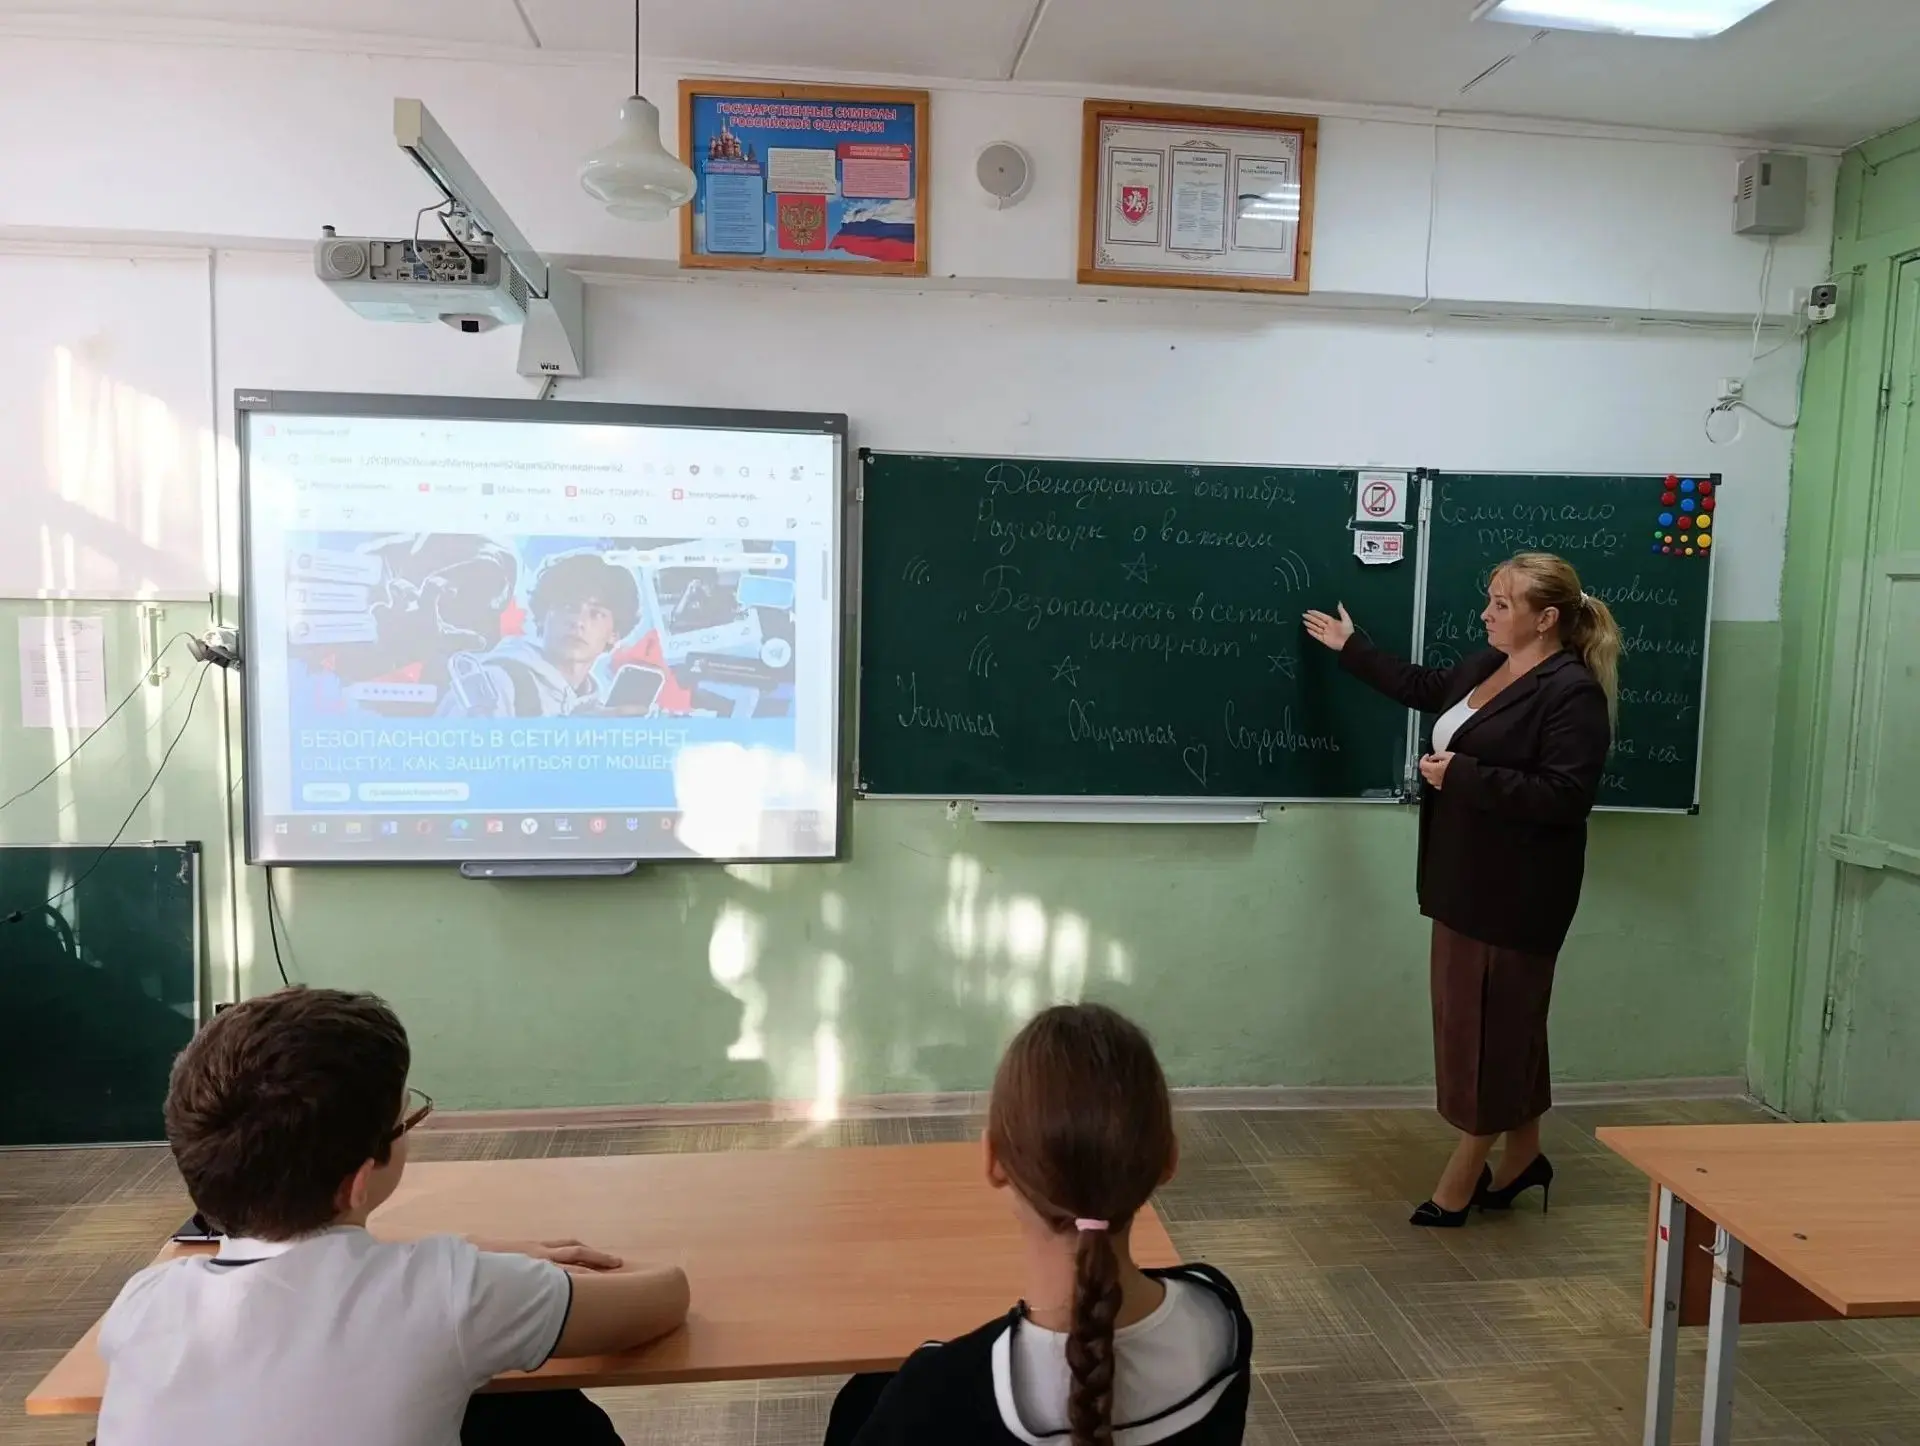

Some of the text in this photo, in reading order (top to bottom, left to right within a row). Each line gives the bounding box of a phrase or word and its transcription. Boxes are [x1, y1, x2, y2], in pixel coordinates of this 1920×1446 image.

[716, 102, 897, 121] ГОСУДАРСТВЕННЫЕ СИМВОЛЫ
[984, 461, 1177, 509] Двенадцатое
[1133, 525, 1147, 542] о
[1210, 602, 1289, 625] сети
[300, 728, 689, 749] БЕЗОПАСНОСТЬ В СЕТИ ИНТЕРНЕТ
[402, 755, 440, 772] КАК
[446, 755, 573, 773] ЗАЩИТИТЬСЯ
[577, 755, 601, 770] ОТ
[607, 755, 674, 770] МОШЕН
